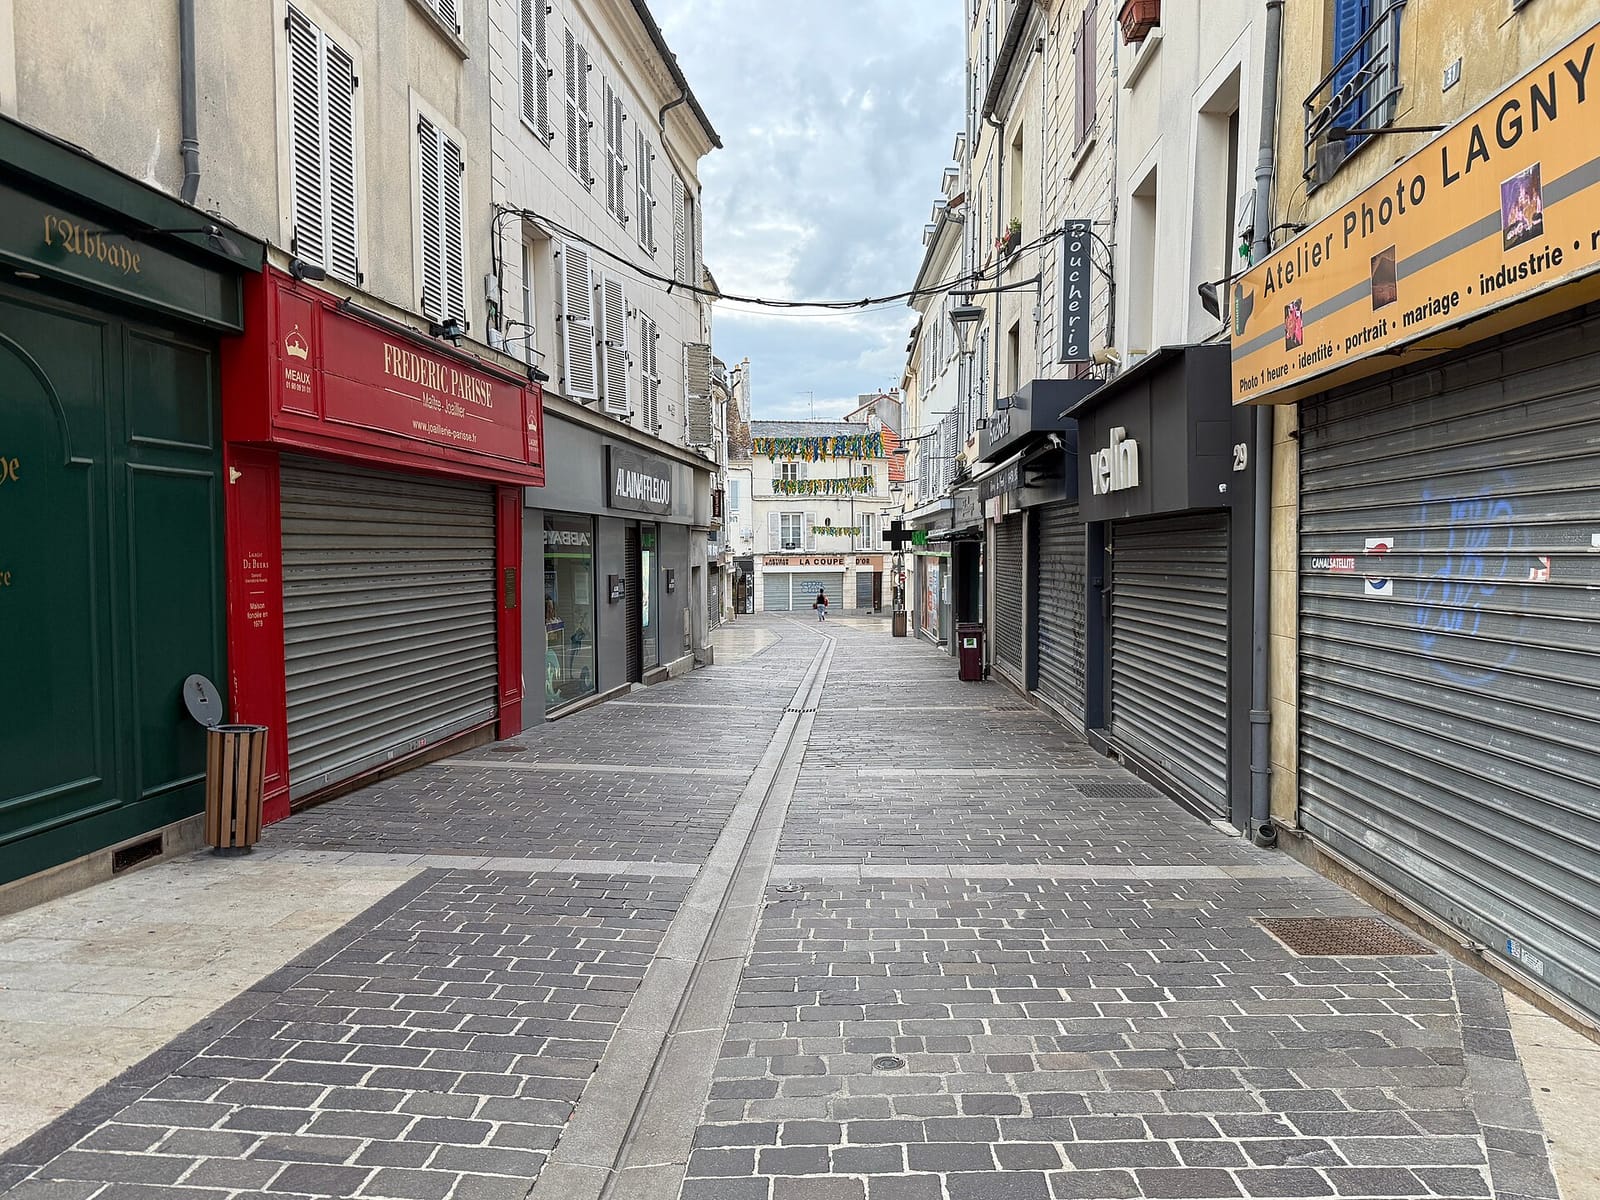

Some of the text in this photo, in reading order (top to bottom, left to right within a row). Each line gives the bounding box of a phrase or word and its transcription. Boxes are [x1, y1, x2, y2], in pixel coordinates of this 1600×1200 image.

[1263, 43, 1595, 298] Atelier Photo LAGNY
[44, 214, 141, 276] l'Abbaye
[1067, 223, 1085, 356] Boucherie
[1239, 374, 1258, 392] Photo
[1261, 370, 1266, 384] 1
[1266, 364, 1289, 382] heure
[1298, 341, 1333, 369] identité
[1345, 318, 1387, 354] portrait
[1402, 290, 1459, 327] mariage
[1479, 245, 1563, 296] industrie
[285, 367, 310, 385] MEAUX
[383, 342, 493, 409] FREDERIC PARISSE
[1233, 443, 1248, 471] 29
[813, 558, 845, 566] COUPE
